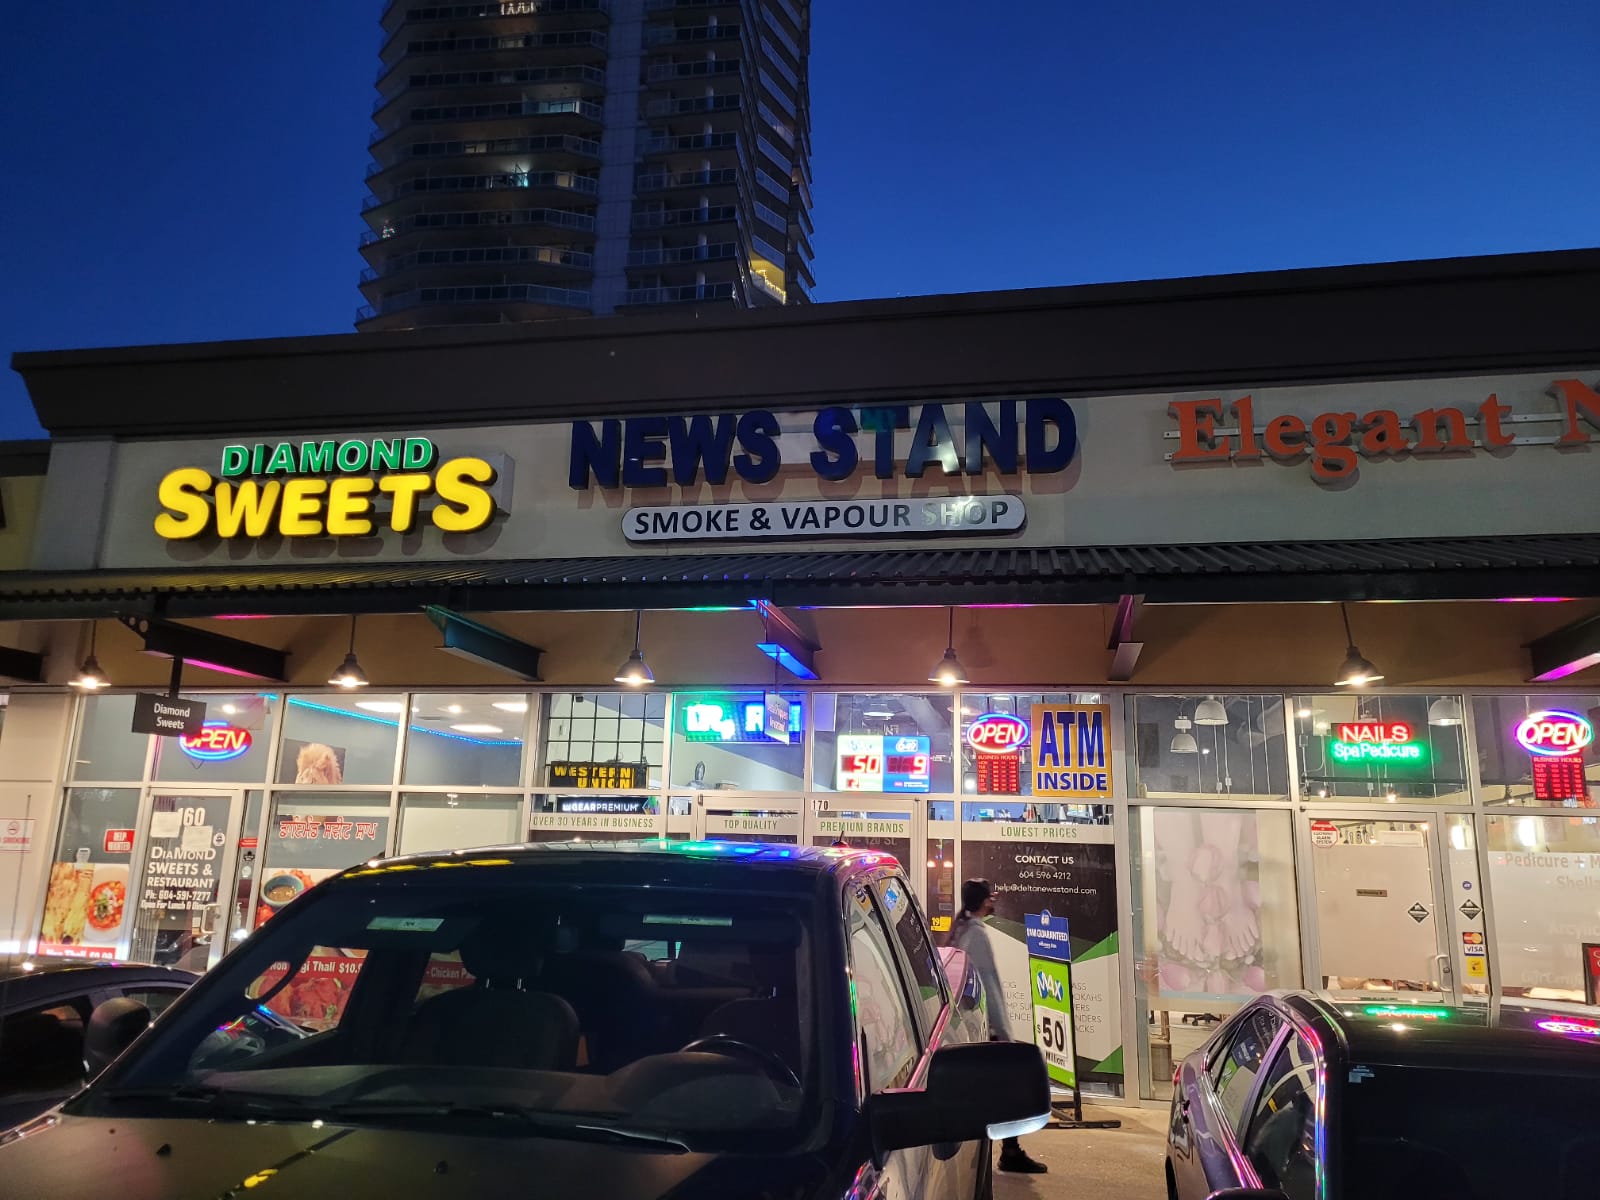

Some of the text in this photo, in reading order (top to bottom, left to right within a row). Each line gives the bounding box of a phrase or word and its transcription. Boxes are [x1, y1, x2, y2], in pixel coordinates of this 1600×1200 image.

[568, 396, 1077, 490] NEWS STAND
[1167, 393, 1516, 479] Elegant
[221, 437, 433, 477] DIAMOND
[154, 457, 498, 540] SWEETS
[634, 499, 1010, 535] SMOKE & VAPOUR SHOP
[153, 703, 191, 718] Diamond
[156, 716, 185, 729] Sweets
[970, 723, 1023, 744] OPEN
[1037, 711, 1106, 768] ATM
[1341, 725, 1409, 743] NAILS
[1525, 722, 1585, 746] OPEN
[1333, 742, 1420, 760] Spa Pedicure
[853, 755, 881, 774] 50
[912, 755, 928, 775] 9
[1036, 772, 1109, 791] INSIDE
[811, 800, 830, 811] 170
[177, 807, 206, 827] 160
[532, 816, 654, 828] OVER 30 YEARS IN BUSINESS
[723, 819, 778, 830] TOP QUALITY
[820, 821, 905, 833] PREMIUM BRANDS
[1000, 826, 1078, 838] LOWEST PRICES
[1014, 855, 1075, 865] CONTACT US
[1504, 852, 1569, 869] Pedicure
[148, 861, 213, 876] SWEETS &
[1018, 870, 1072, 880] 604 596 4212
[146, 876, 215, 889] RESTAURANT
[994, 883, 1097, 895] help@deltanewsstand.com
[158, 890, 212, 901] 604-591-7277
[1036, 929, 1068, 942] GUARANTEED
[312, 960, 336, 972] Thali
[431, 967, 460, 979] Chicken
[1036, 970, 1064, 1002] MAX
[1075, 992, 1103, 1002] OKAHS
[1075, 1014, 1102, 1023] NDERS
[1042, 1016, 1065, 1052] 50
